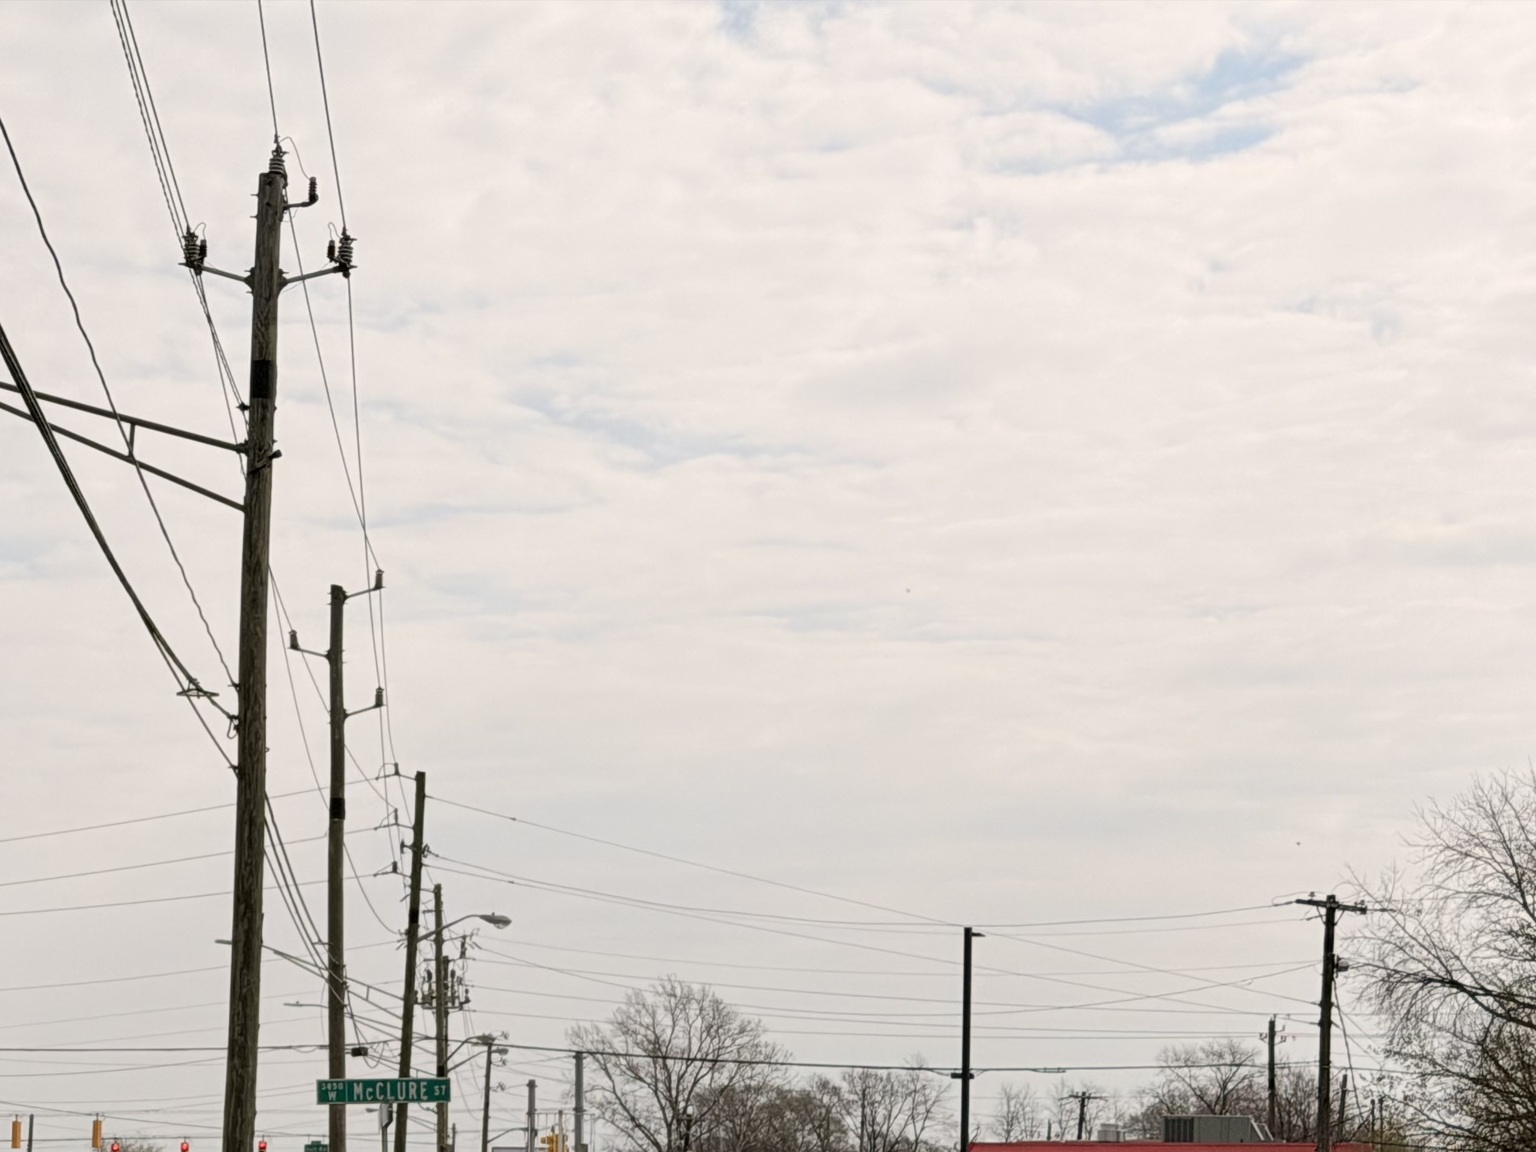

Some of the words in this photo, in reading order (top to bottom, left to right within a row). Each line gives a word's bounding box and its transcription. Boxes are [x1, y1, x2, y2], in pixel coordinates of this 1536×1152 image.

[327, 1091, 337, 1101] W
[353, 1081, 428, 1101] McCLURE
[434, 1085, 446, 1096] ST
